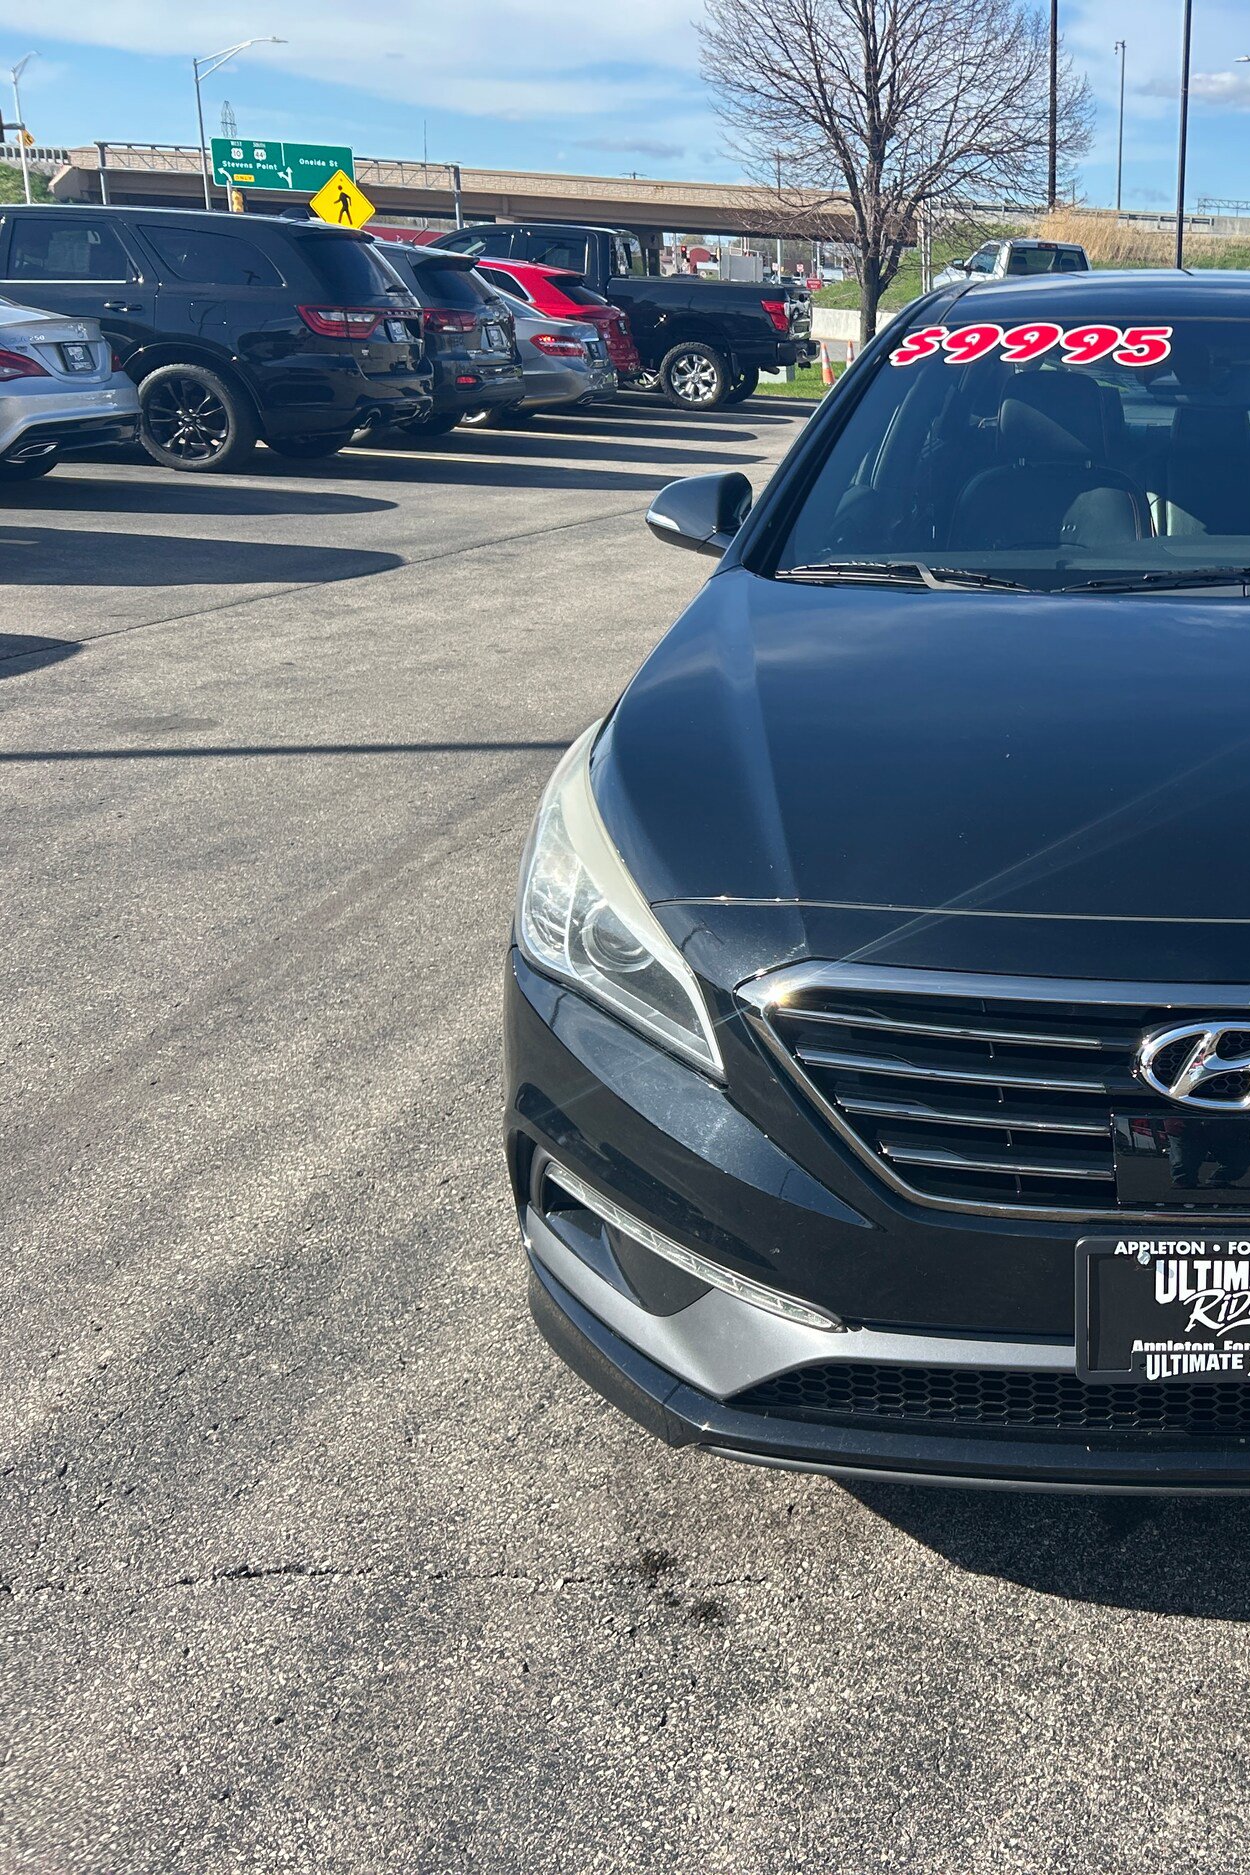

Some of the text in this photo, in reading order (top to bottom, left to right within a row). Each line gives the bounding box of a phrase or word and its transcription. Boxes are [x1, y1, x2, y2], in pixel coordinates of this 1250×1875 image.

[221, 160, 278, 171] Stevens Point
[299, 158, 338, 168] Oneida St
[888, 322, 1173, 367] $9995
[1114, 1241, 1206, 1256] APPLETON
[1146, 1353, 1244, 1381] ULTIMATE
